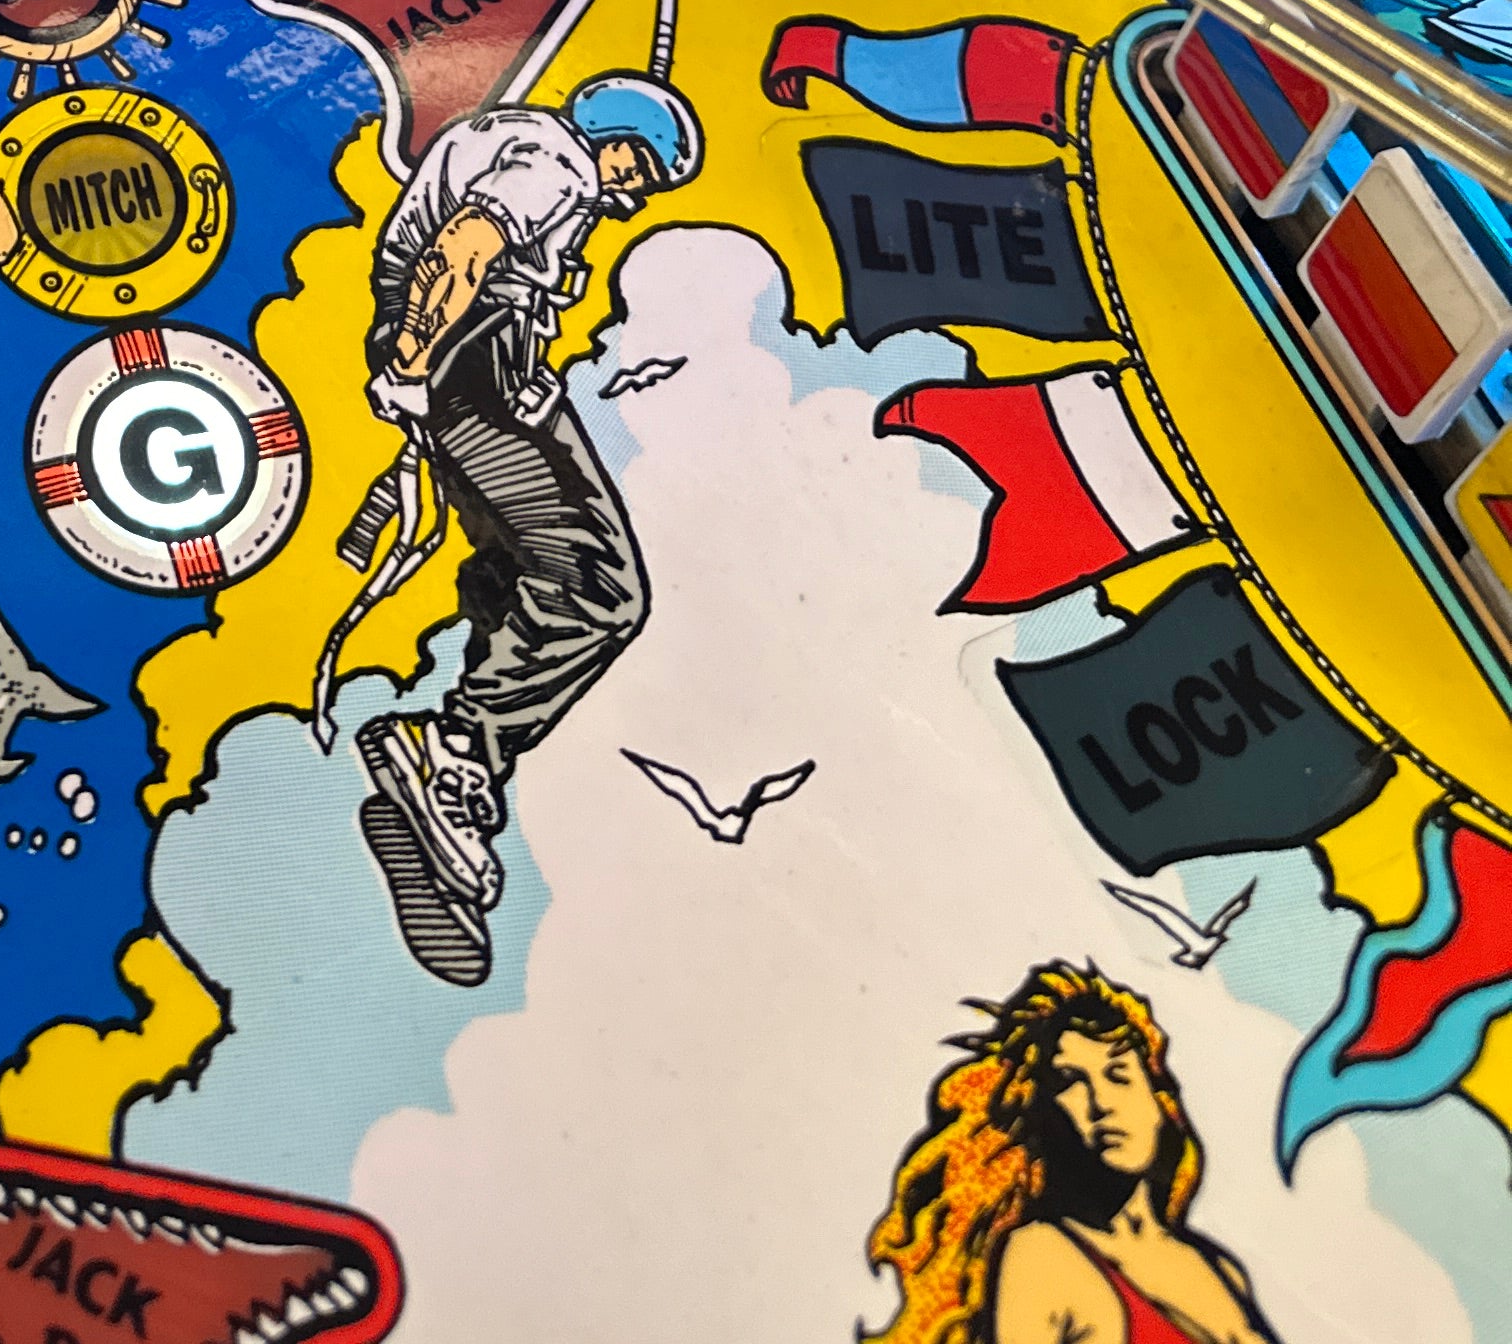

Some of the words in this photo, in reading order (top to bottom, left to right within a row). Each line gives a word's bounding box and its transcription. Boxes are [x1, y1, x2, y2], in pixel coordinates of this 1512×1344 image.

[43, 162, 164, 236] MITCH
[851, 192, 1057, 286] LITE
[118, 406, 227, 505] G
[1078, 641, 1298, 815] LOCK
[6, 1224, 163, 1340] JACK
